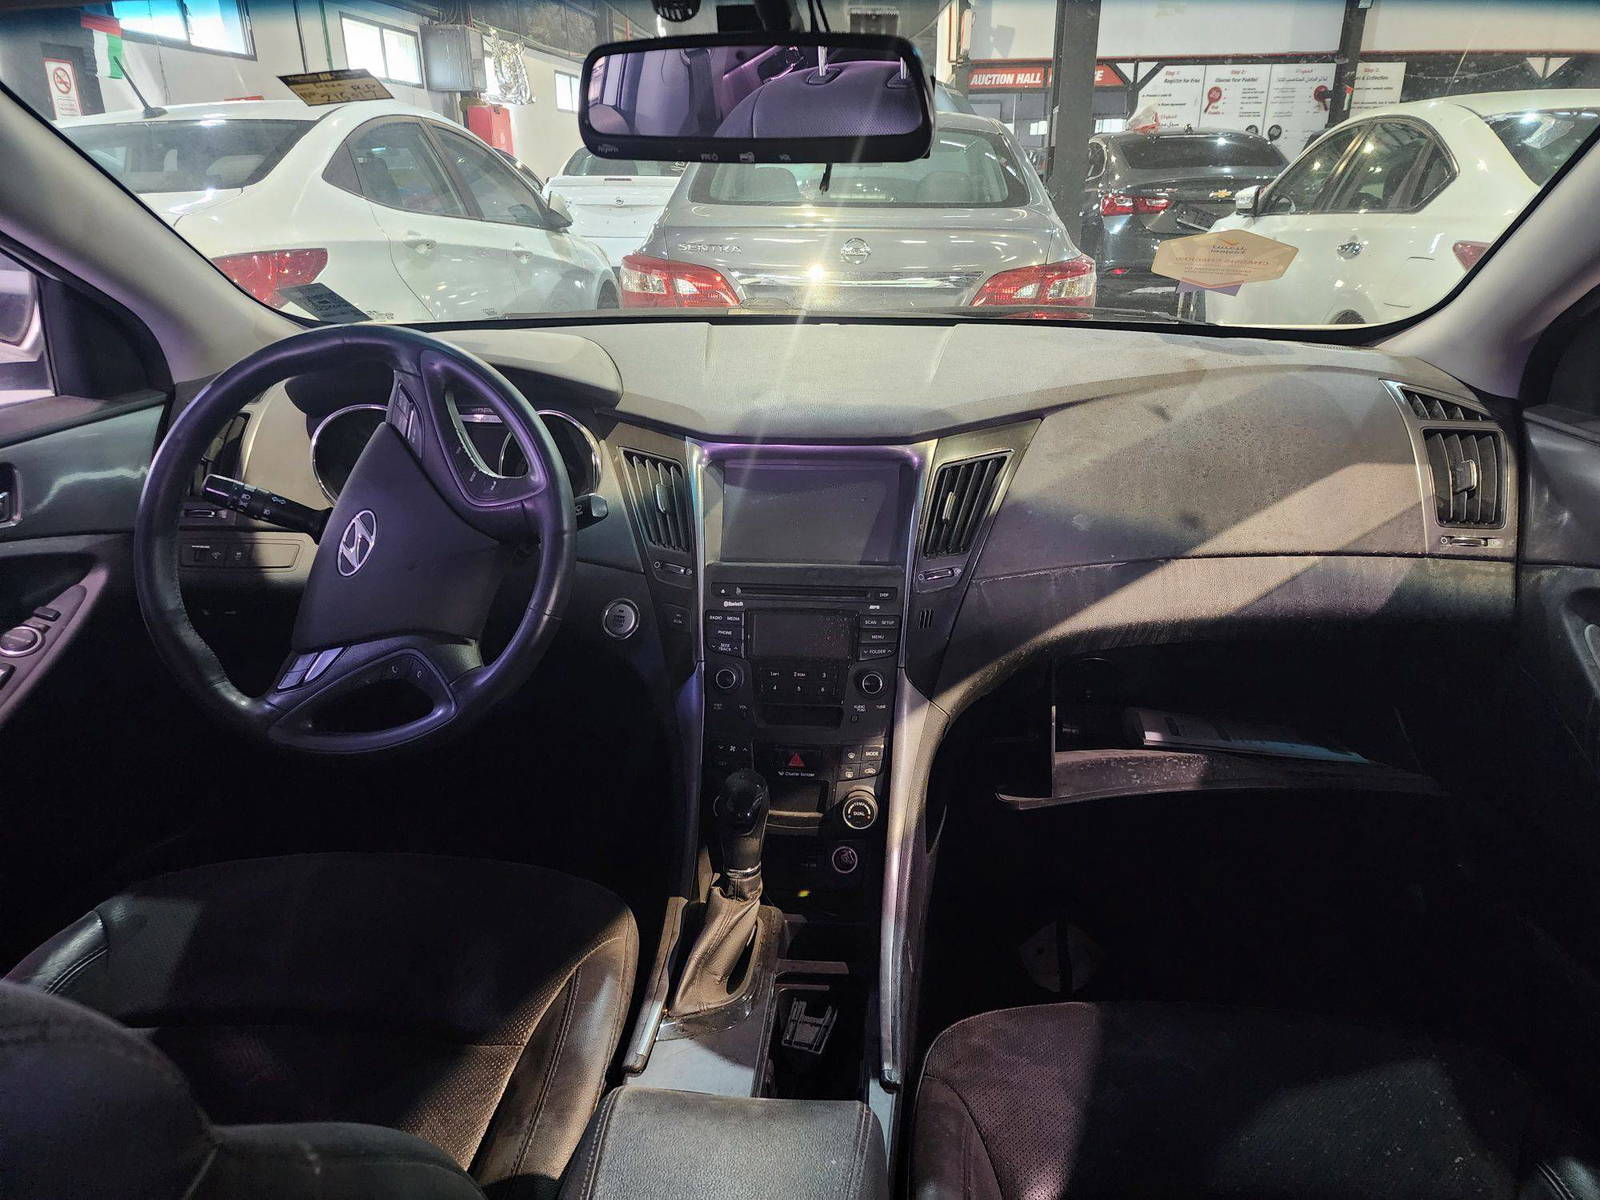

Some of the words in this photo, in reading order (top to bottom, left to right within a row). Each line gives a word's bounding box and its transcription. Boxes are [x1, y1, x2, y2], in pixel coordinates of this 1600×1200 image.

[970, 74, 1014, 85] AUCTION
[1015, 72, 1042, 84] HALL
[679, 242, 743, 254] SENTRA
